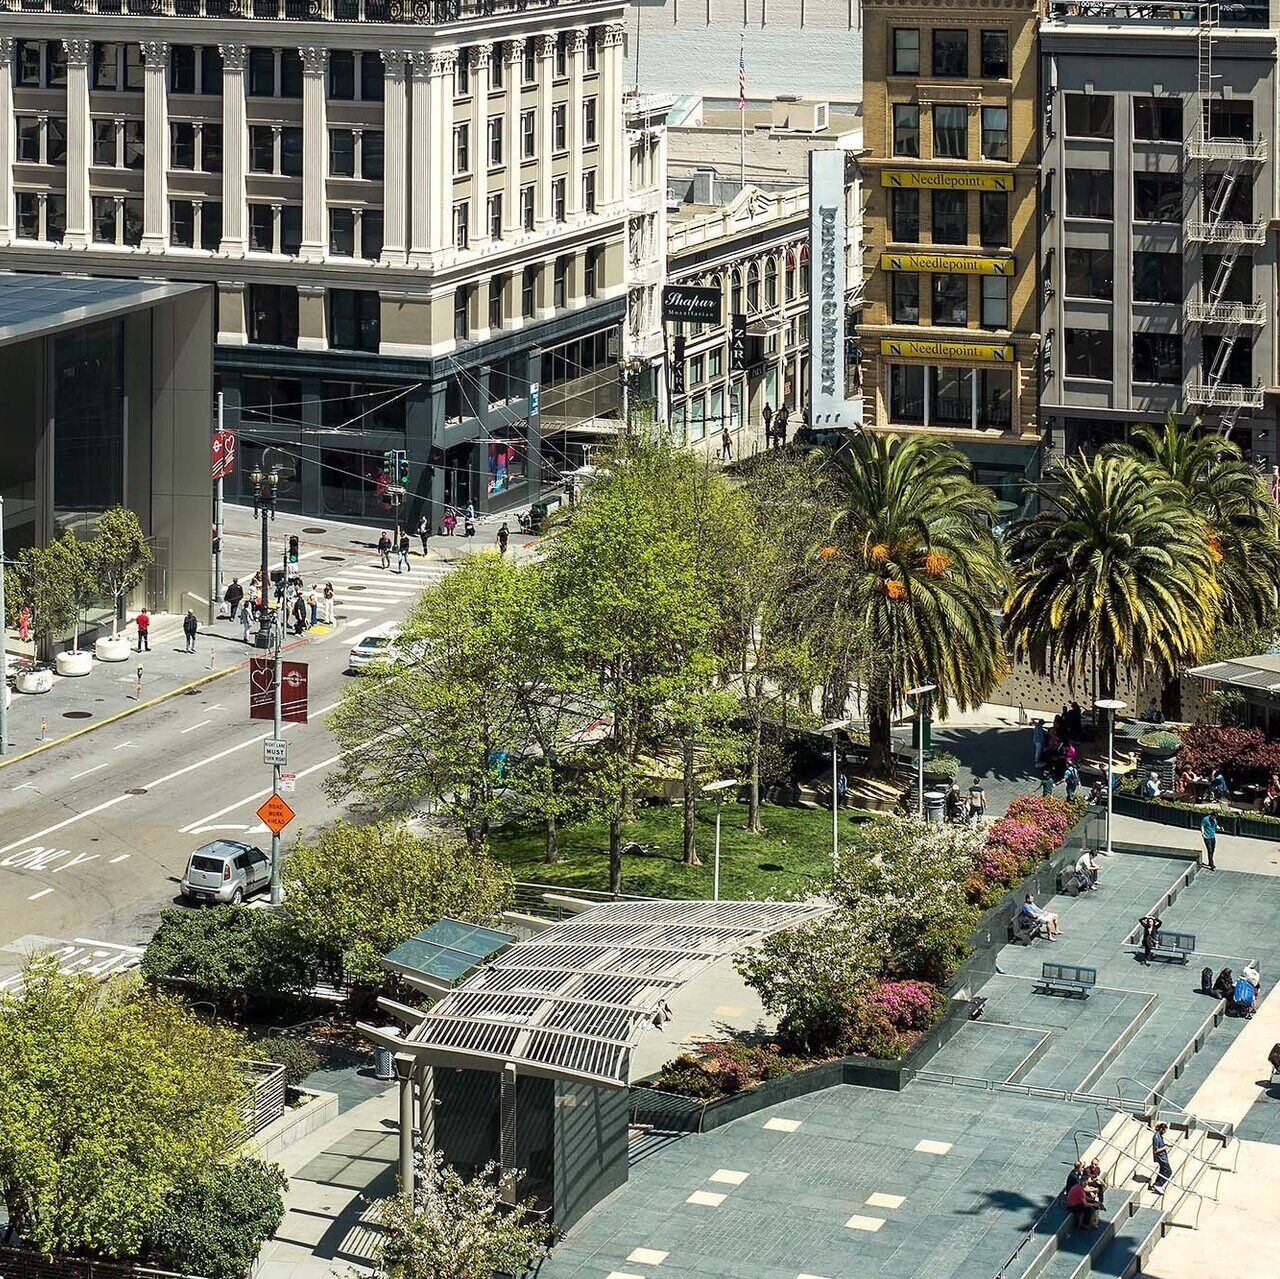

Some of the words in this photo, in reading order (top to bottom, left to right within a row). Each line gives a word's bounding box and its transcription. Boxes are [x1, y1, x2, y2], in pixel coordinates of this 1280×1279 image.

[911, 173, 980, 188] Needlepoint
[909, 256, 978, 271] Needlepoint
[664, 291, 716, 311] Shapur
[733, 328, 745, 370] ZARA
[909, 342, 978, 357] Needlepoint
[0, 846, 101, 872] ONLY
